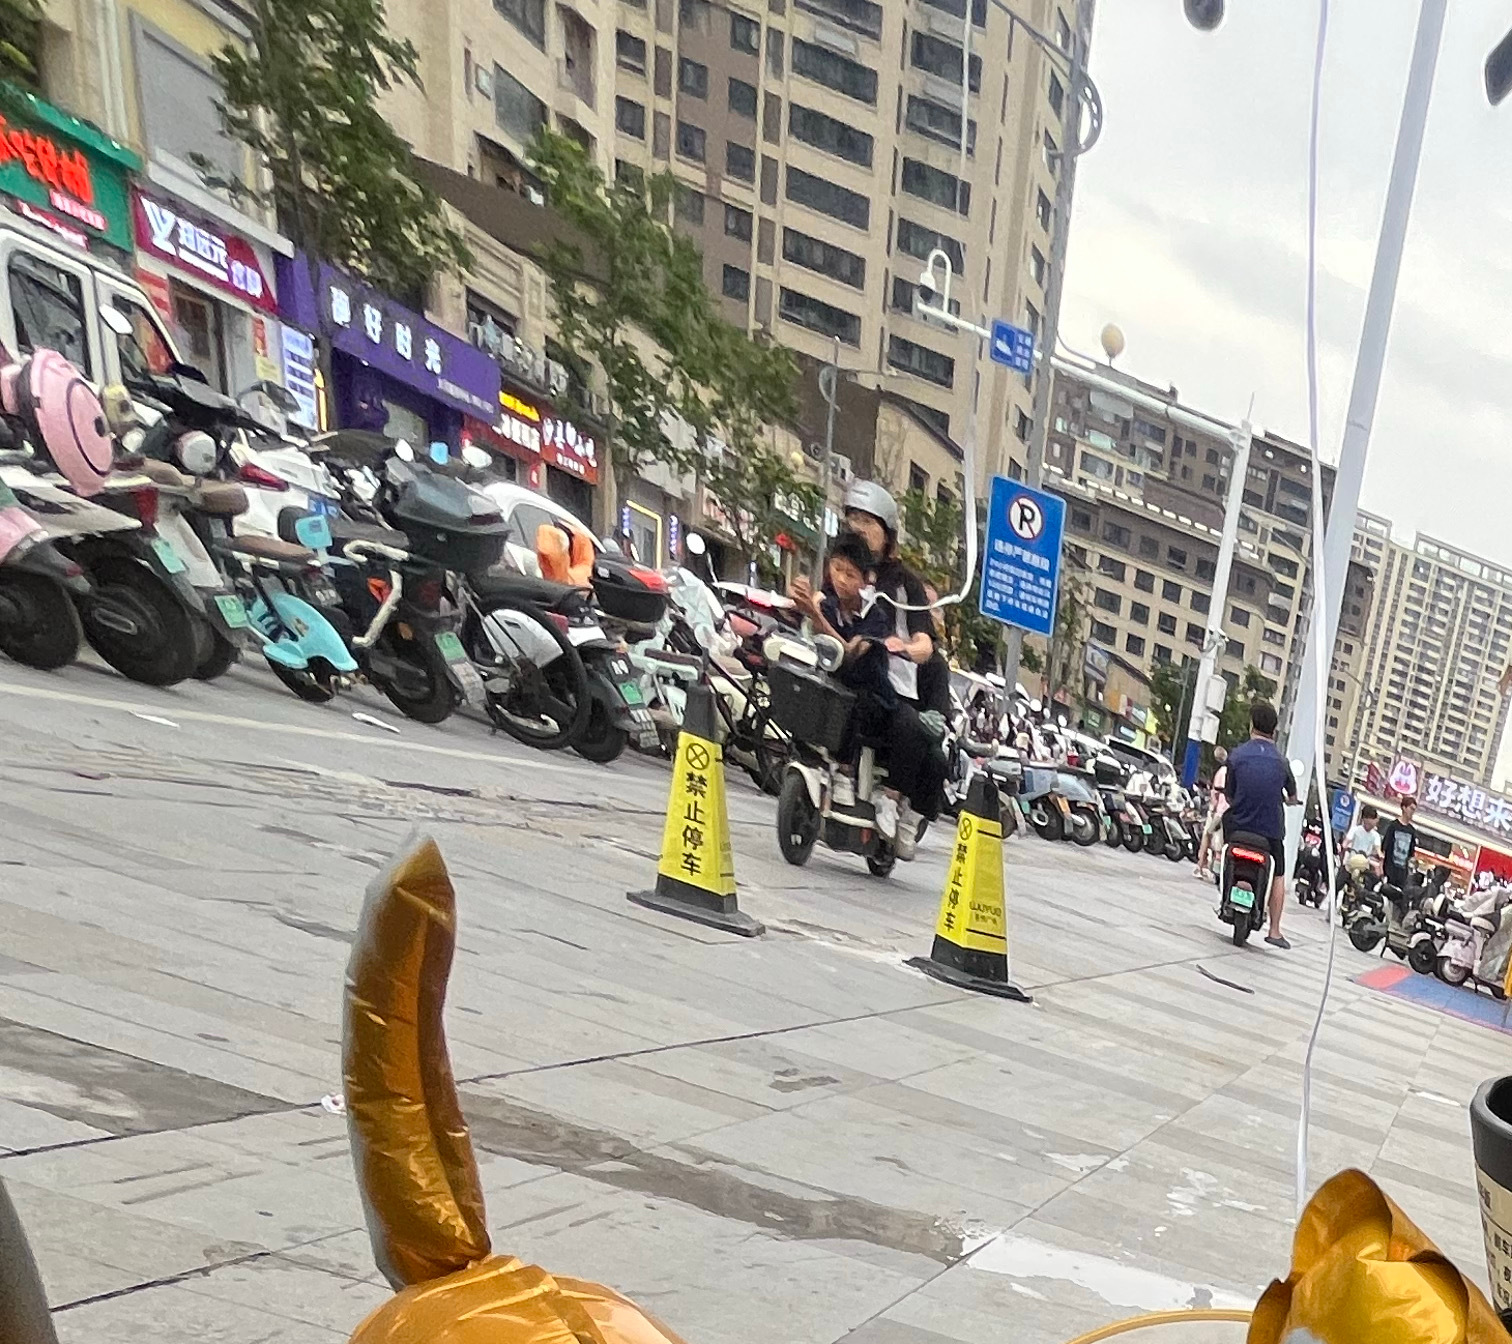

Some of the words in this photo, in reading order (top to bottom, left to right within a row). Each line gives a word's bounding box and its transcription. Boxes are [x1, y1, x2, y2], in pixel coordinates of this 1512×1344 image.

[681, 771, 708, 877] 禁止停车
[944, 843, 968, 932] 禁止停车
